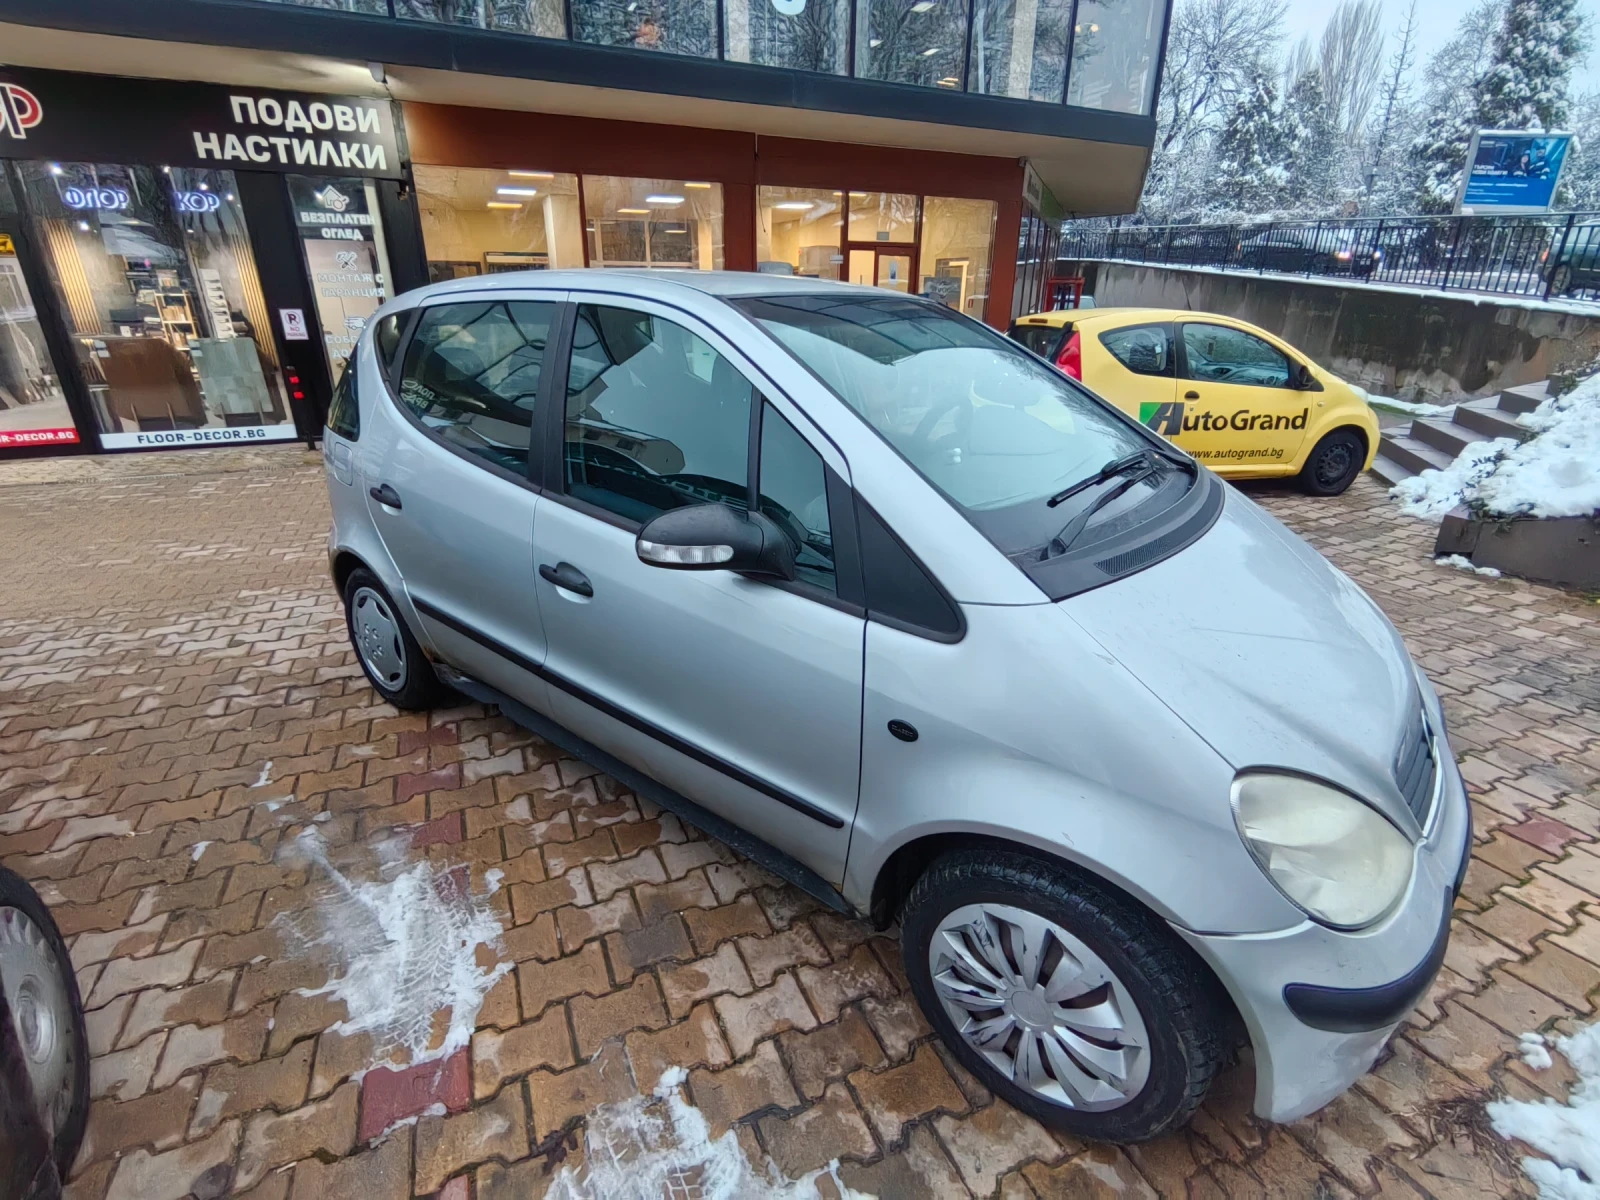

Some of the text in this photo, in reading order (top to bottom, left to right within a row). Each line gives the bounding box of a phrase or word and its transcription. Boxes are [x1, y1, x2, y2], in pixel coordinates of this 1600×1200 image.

[0, 82, 43, 139] Р
[229, 95, 381, 134] ПОДОВИ
[193, 131, 387, 170] НАСТИЛКИ
[321, 227, 364, 241] ОГЛЕД
[317, 272, 373, 283] МОНТАЖ
[321, 287, 386, 298] ГАРАНЦИЯ
[326, 335, 358, 344] СОБС
[1146, 402, 1309, 436] AutoGrand
[0, 431, 75, 443] R-DECOR.BG
[137, 429, 266, 444] FLOOR-DECOR.BG
